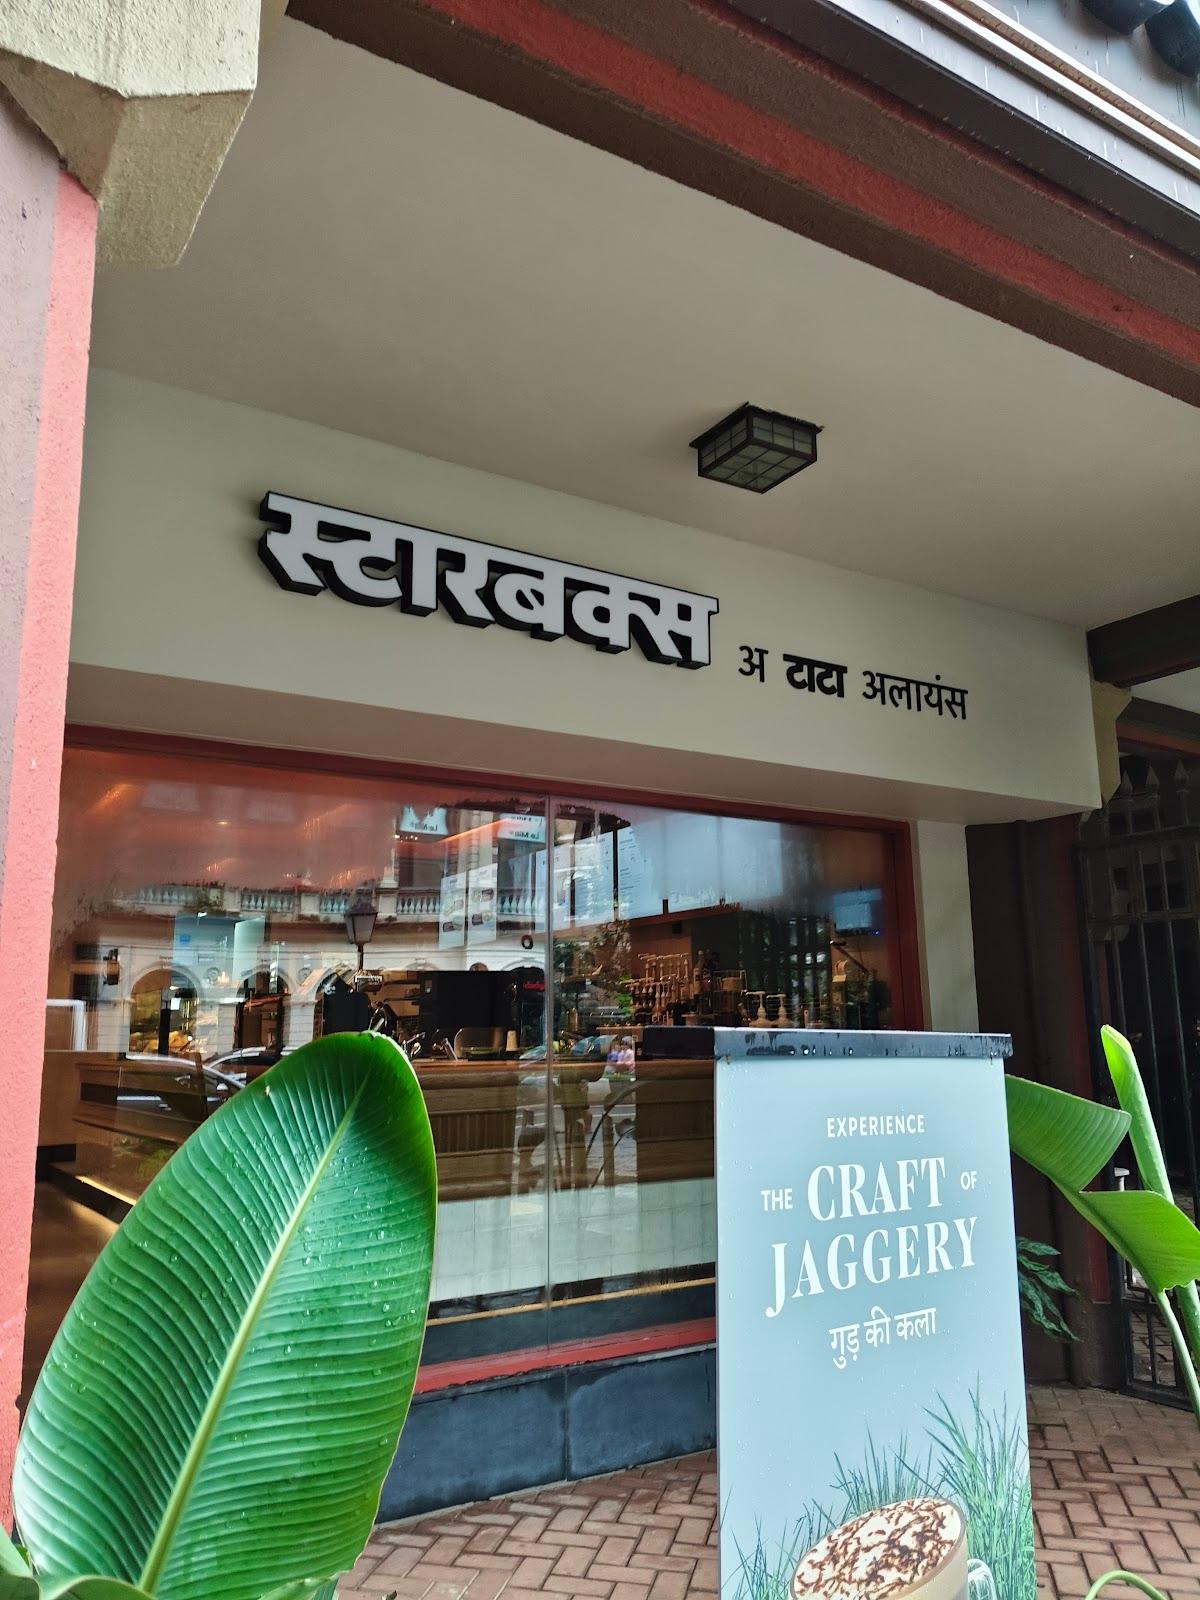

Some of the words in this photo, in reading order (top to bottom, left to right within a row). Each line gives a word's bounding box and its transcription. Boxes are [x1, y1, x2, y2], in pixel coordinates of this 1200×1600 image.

[258, 491, 719, 669] स्टारबक्स
[738, 645, 768, 683] अ
[783, 653, 848, 698] टाटा
[862, 670, 968, 720] अलायंस
[826, 1114, 925, 1138] EXPERIENCE
[761, 1188, 793, 1212] THE
[807, 1157, 946, 1221] CRAFT
[960, 1171, 977, 1191] OF
[765, 1216, 978, 1318] JAGGERY
[829, 1323, 860, 1369] गुड़
[864, 1305, 891, 1348] की
[894, 1307, 937, 1342] कला
